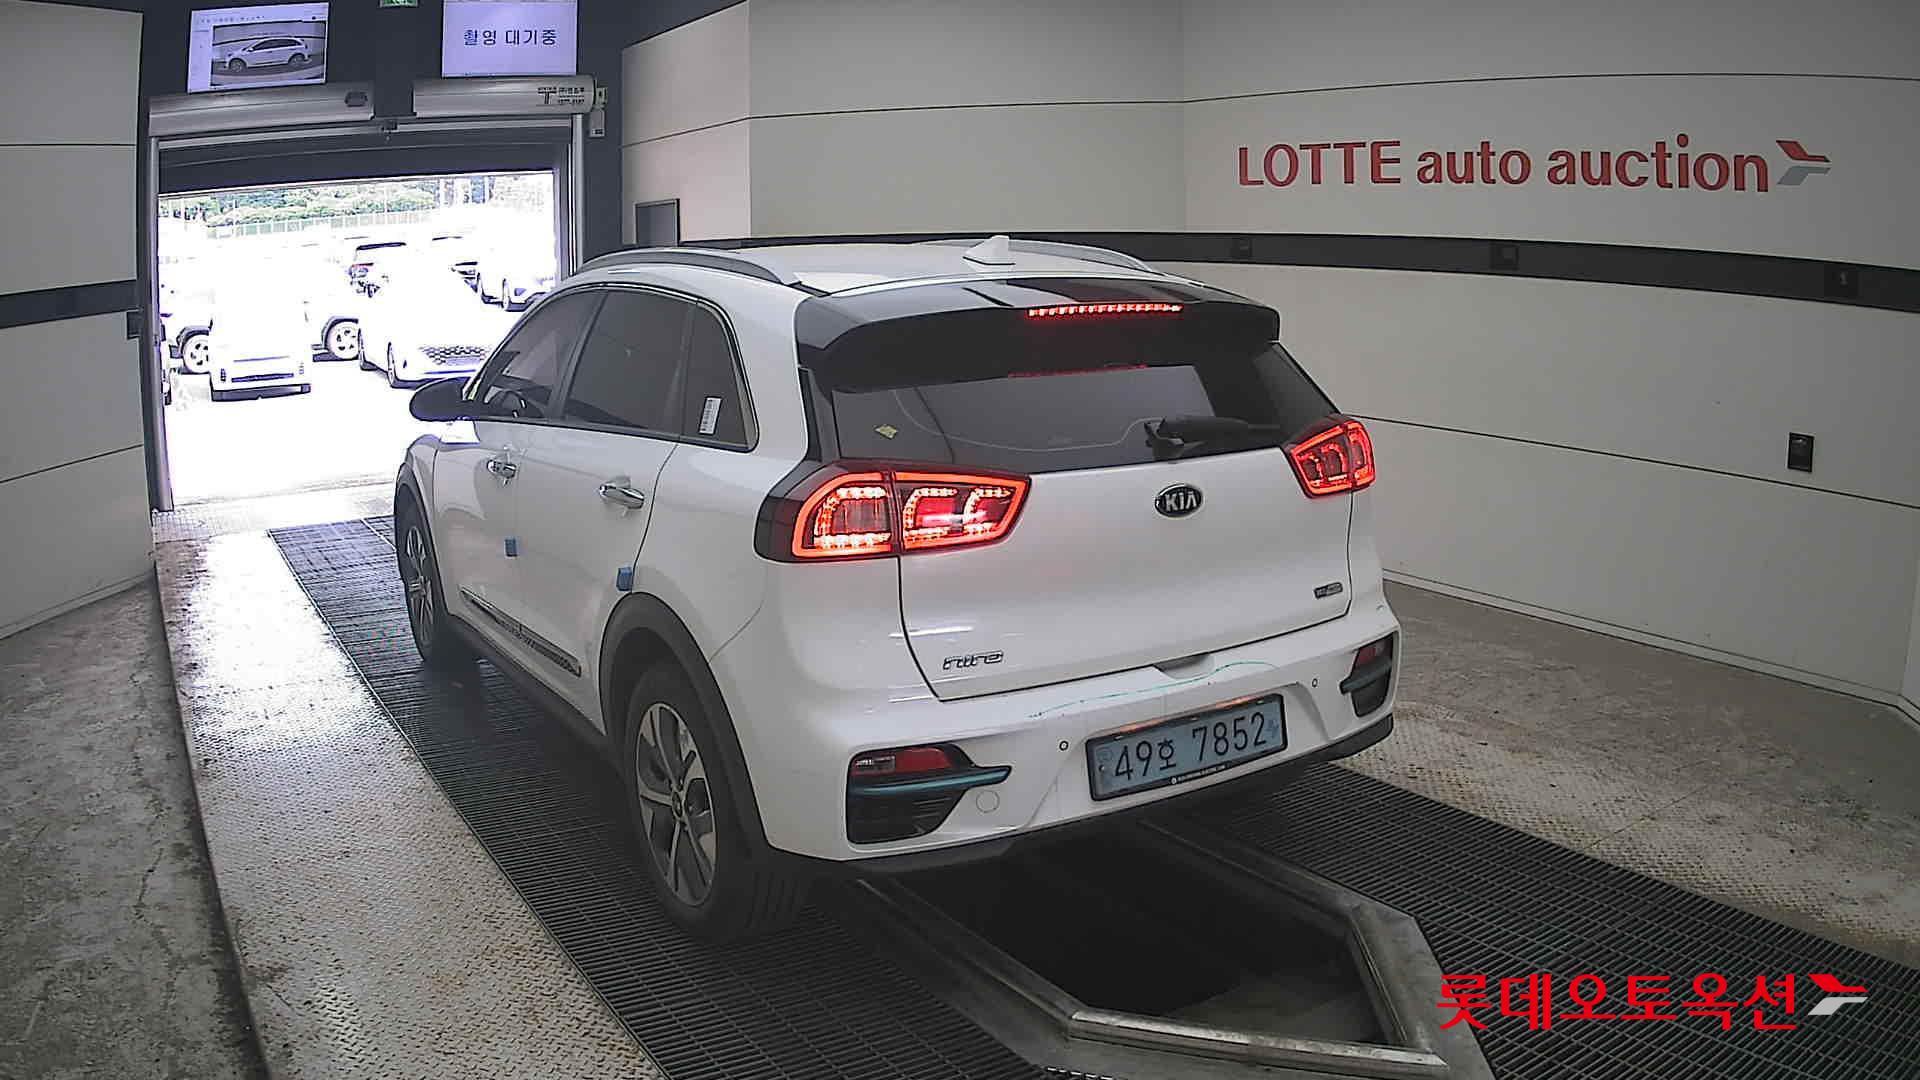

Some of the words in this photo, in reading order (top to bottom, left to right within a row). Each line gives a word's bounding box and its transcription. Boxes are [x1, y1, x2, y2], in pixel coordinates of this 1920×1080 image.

[464, 29, 497, 46] 촬영
[505, 29, 557, 46] 대기중
[1238, 140, 1401, 188] LOTTE
[1416, 140, 1532, 186] auto
[1546, 133, 1769, 193] auction
[1115, 738, 1177, 781] 49호
[1192, 711, 1267, 762] 7852
